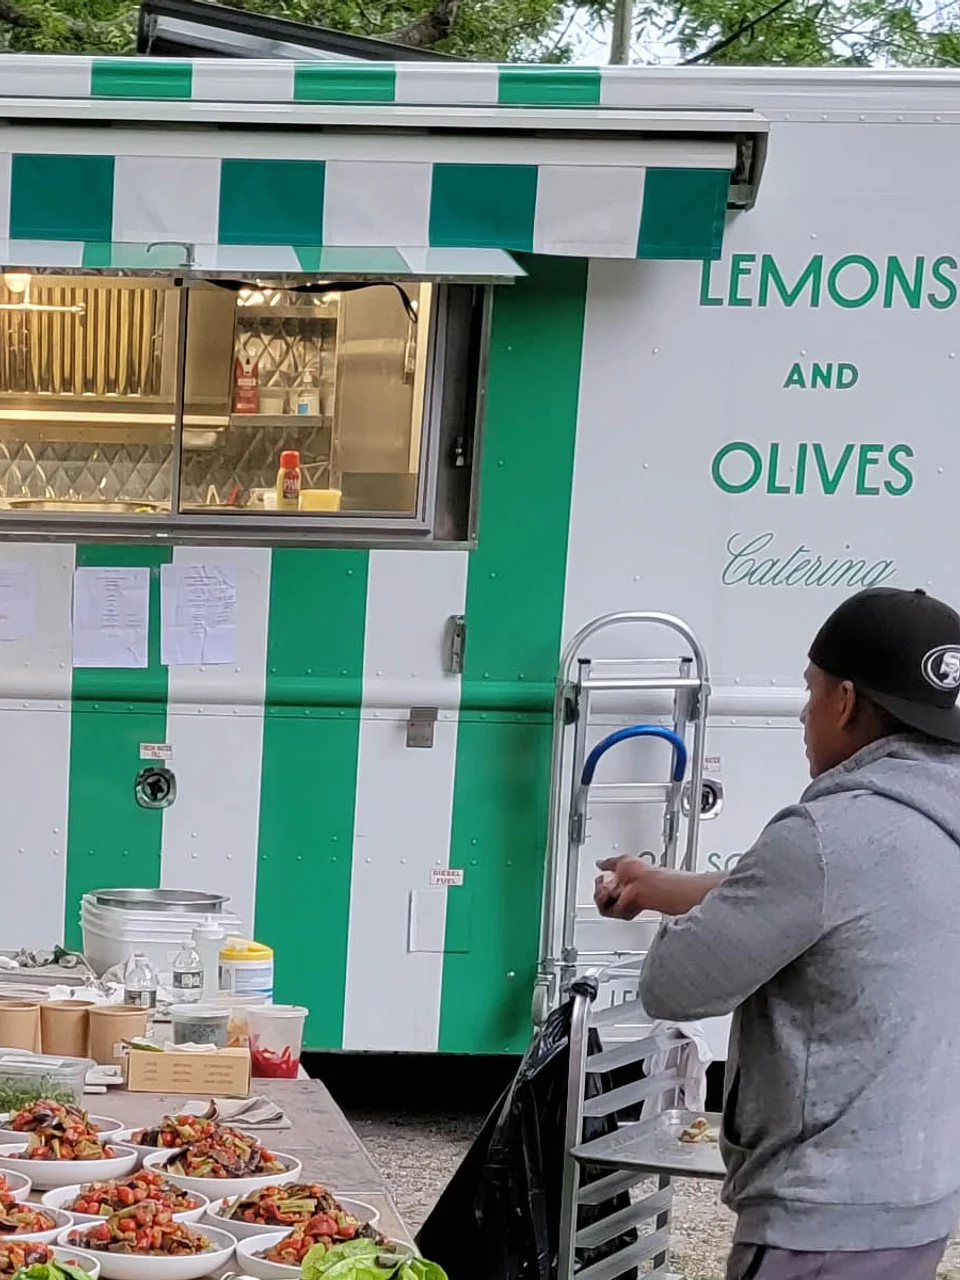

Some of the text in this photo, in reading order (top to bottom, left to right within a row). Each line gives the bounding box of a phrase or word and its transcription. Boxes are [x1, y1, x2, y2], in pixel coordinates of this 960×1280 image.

[699, 253, 958, 309] LEMONS
[783, 362, 859, 389] AND
[711, 441, 915, 496] OLIVES
